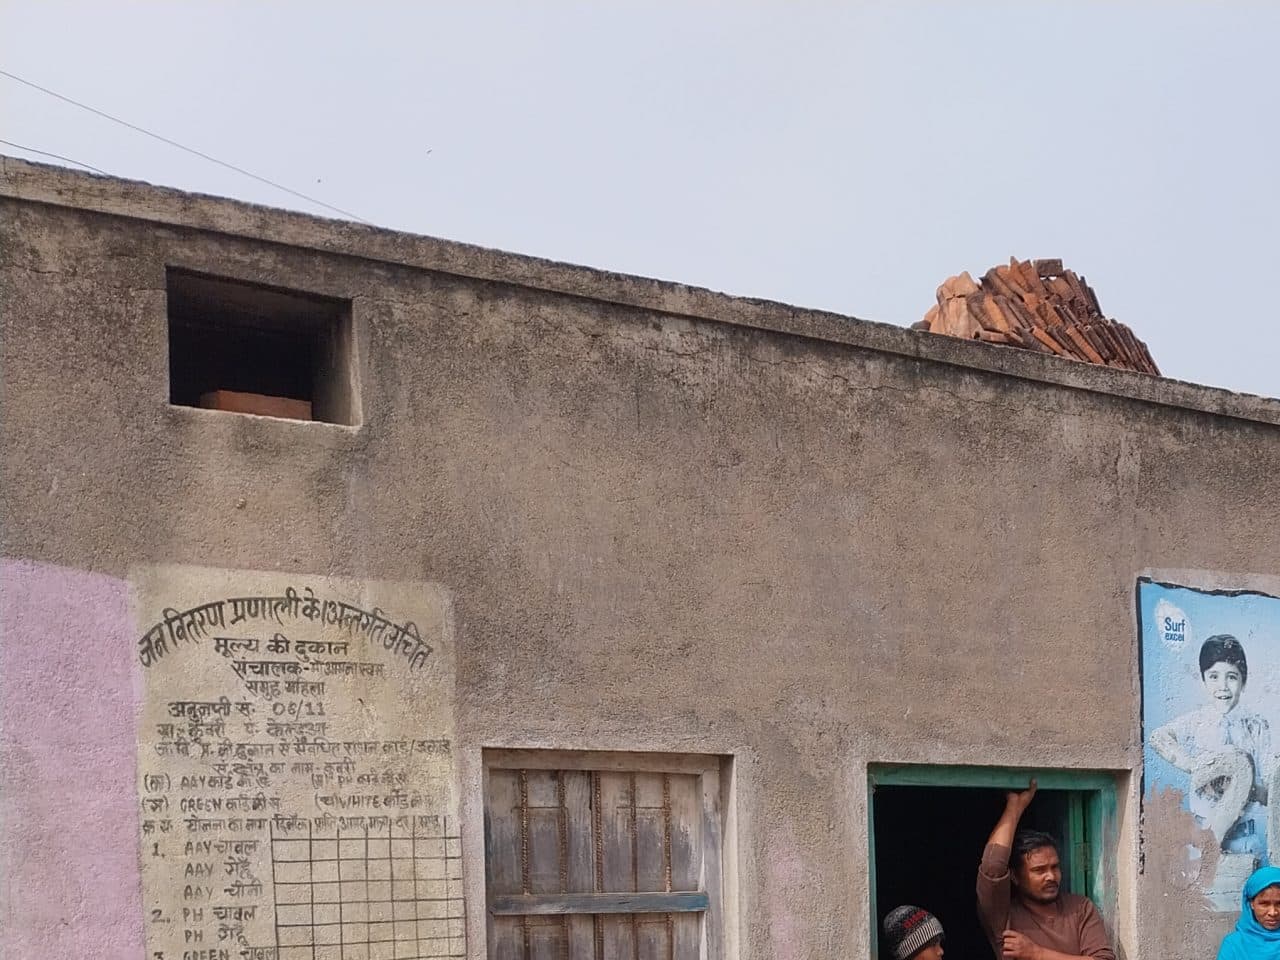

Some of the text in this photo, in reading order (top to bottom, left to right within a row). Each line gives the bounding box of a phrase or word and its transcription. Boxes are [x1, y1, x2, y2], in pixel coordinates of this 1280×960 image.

[227, 586, 302, 627] प्रणाली
[1164, 616, 1186, 632] Surf
[1164, 632, 1185, 642] excel
[213, 632, 349, 662] मूल्य की दुकान
[272, 699, 326, 721] 06/11
[184, 840, 212, 856] AAY
[184, 862, 214, 878] AAY
[184, 885, 214, 900] AAY
[183, 907, 204, 922] PH
[213, 905, 258, 921] चावल
[184, 929, 204, 944] PH
